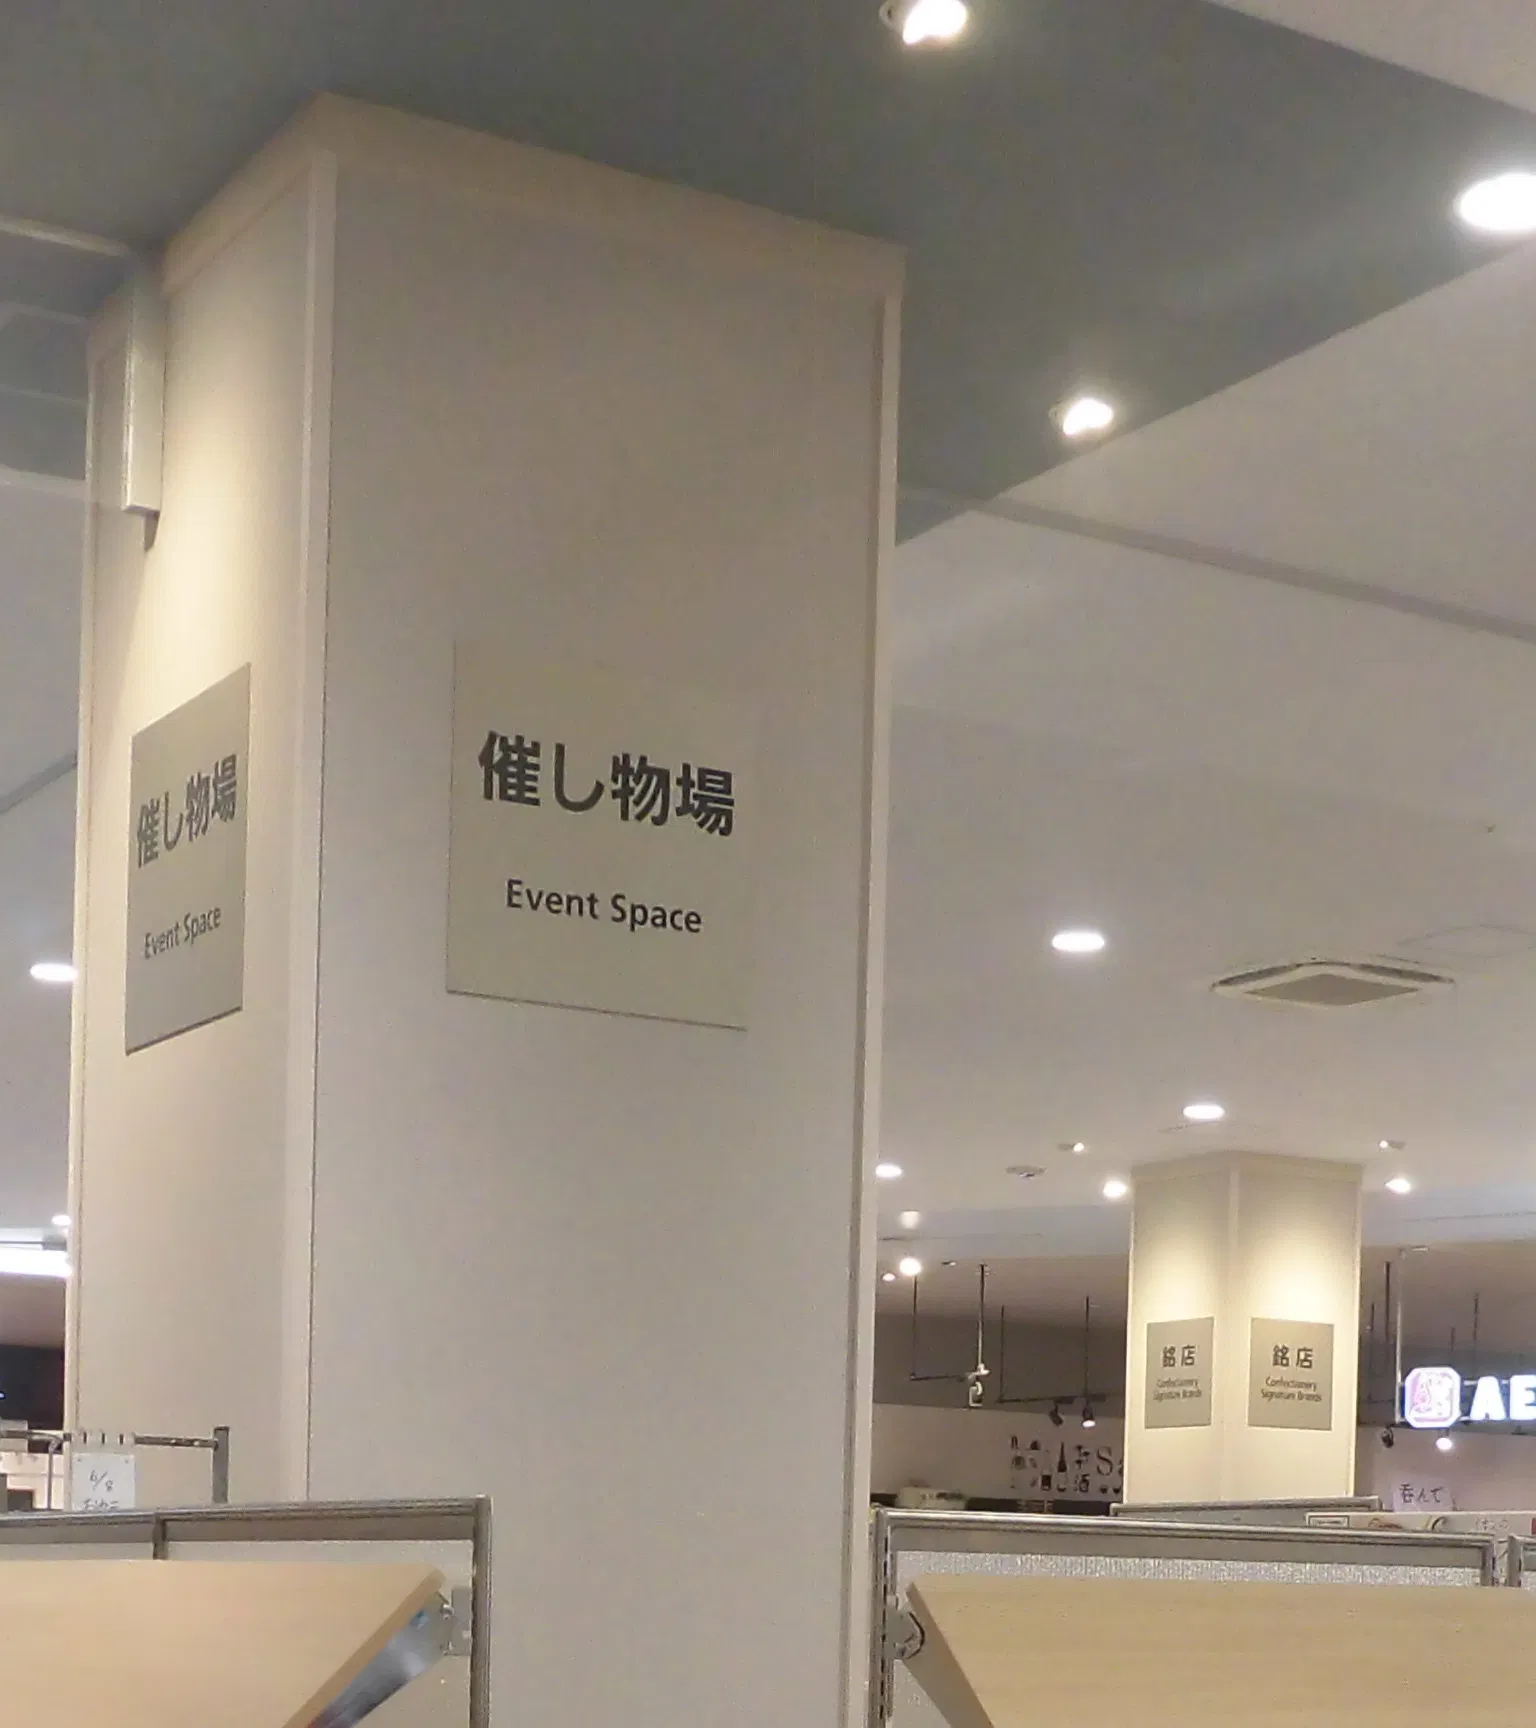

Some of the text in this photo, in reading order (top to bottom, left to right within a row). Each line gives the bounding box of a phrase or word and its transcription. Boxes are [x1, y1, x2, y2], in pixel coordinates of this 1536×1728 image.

[478, 730, 735, 836] 催し物場
[137, 754, 237, 868] 催し物場
[506, 878, 702, 933] Event Space
[144, 907, 222, 959] Event Space
[1163, 1344, 1197, 1368] 銘店
[1272, 1344, 1314, 1369] 銘店
